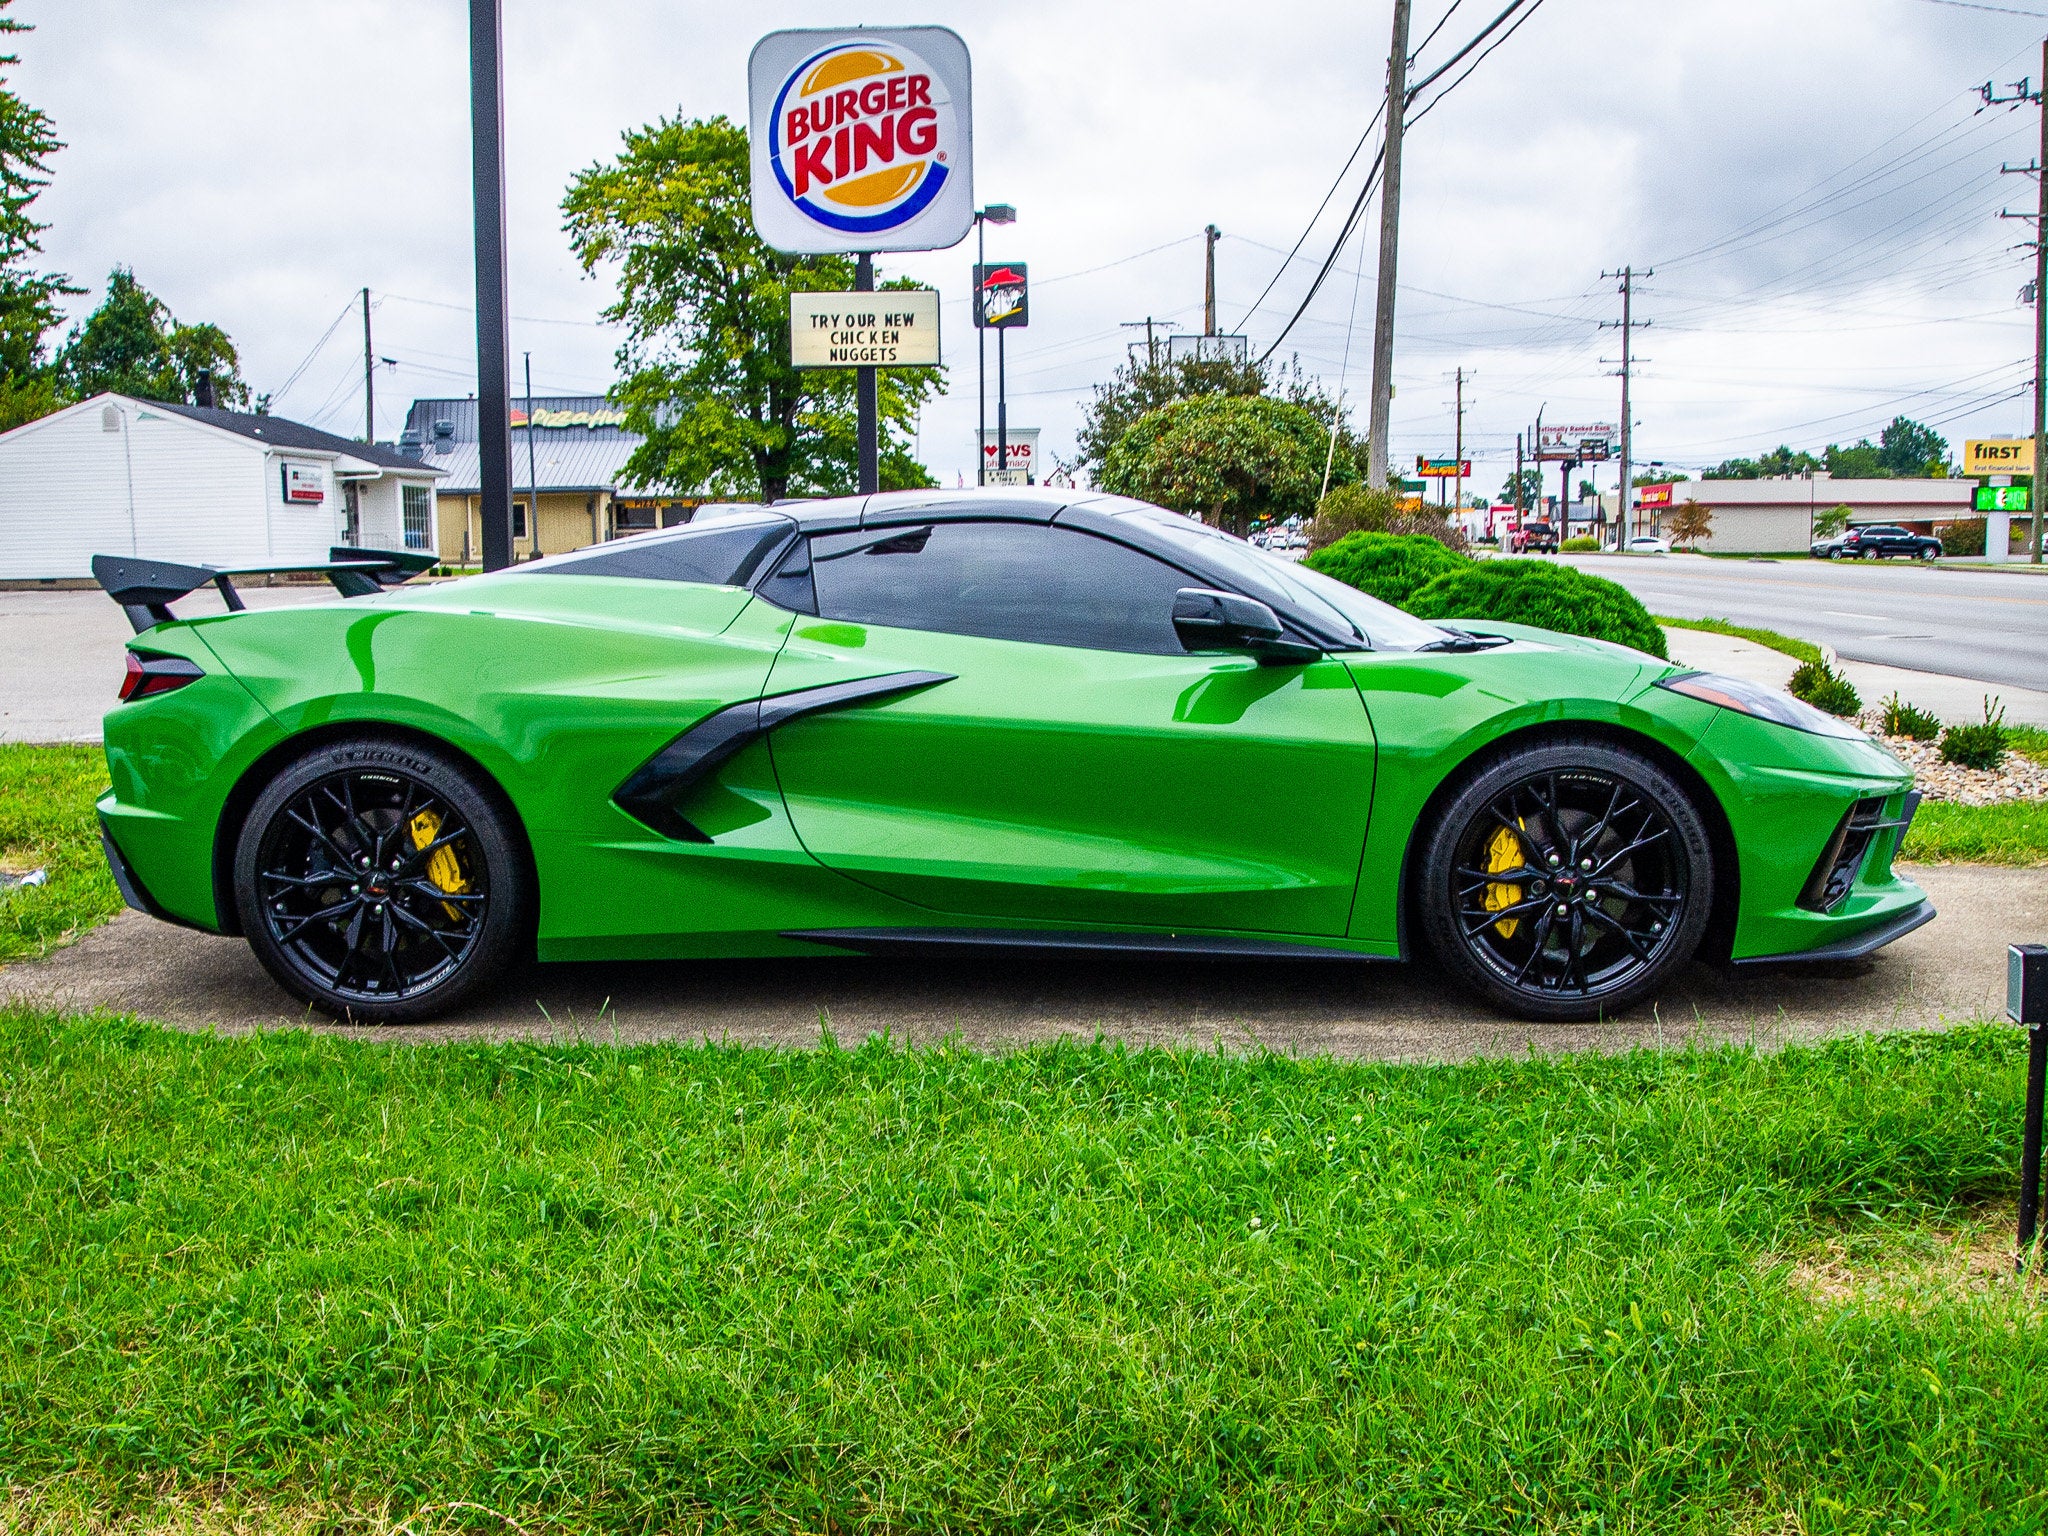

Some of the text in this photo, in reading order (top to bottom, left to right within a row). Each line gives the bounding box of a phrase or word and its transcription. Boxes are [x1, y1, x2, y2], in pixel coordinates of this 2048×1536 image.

[788, 74, 932, 147] BURGER
[794, 107, 938, 197] KING
[810, 313, 915, 328] TRY OUR NEW
[830, 331, 899, 345] CHICKEN
[829, 348, 897, 361] NUGGETS
[532, 407, 589, 429] Pizza
[1540, 426, 1568, 434] ationally
